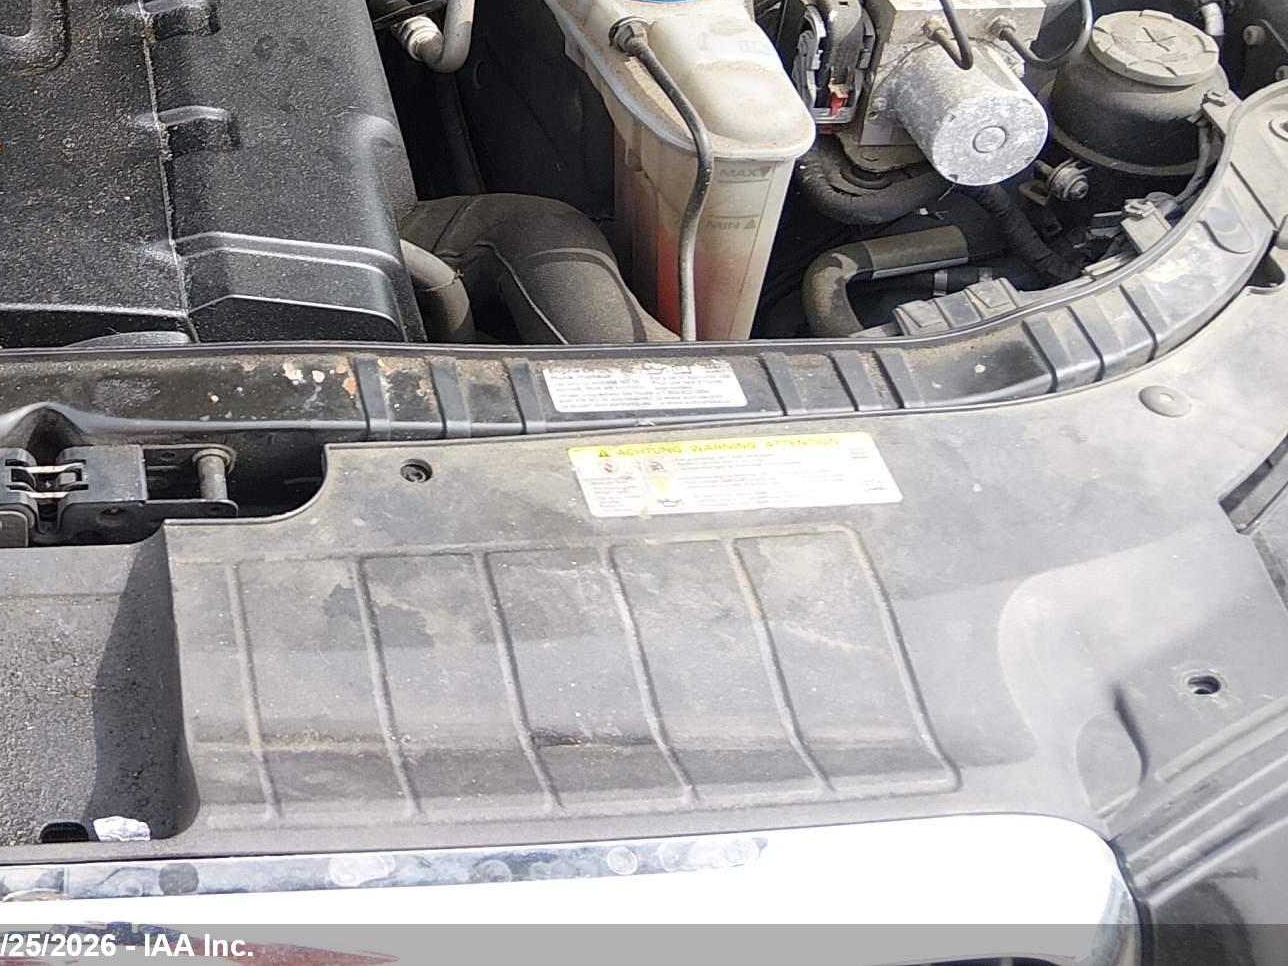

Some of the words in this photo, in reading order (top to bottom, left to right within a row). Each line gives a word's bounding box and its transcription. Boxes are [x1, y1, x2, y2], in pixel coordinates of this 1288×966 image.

[719, 169, 758, 178] MAX
[617, 445, 682, 456] ACHTUNG
[690, 441, 757, 453] WARNING
[764, 436, 840, 449] ATTENTION
